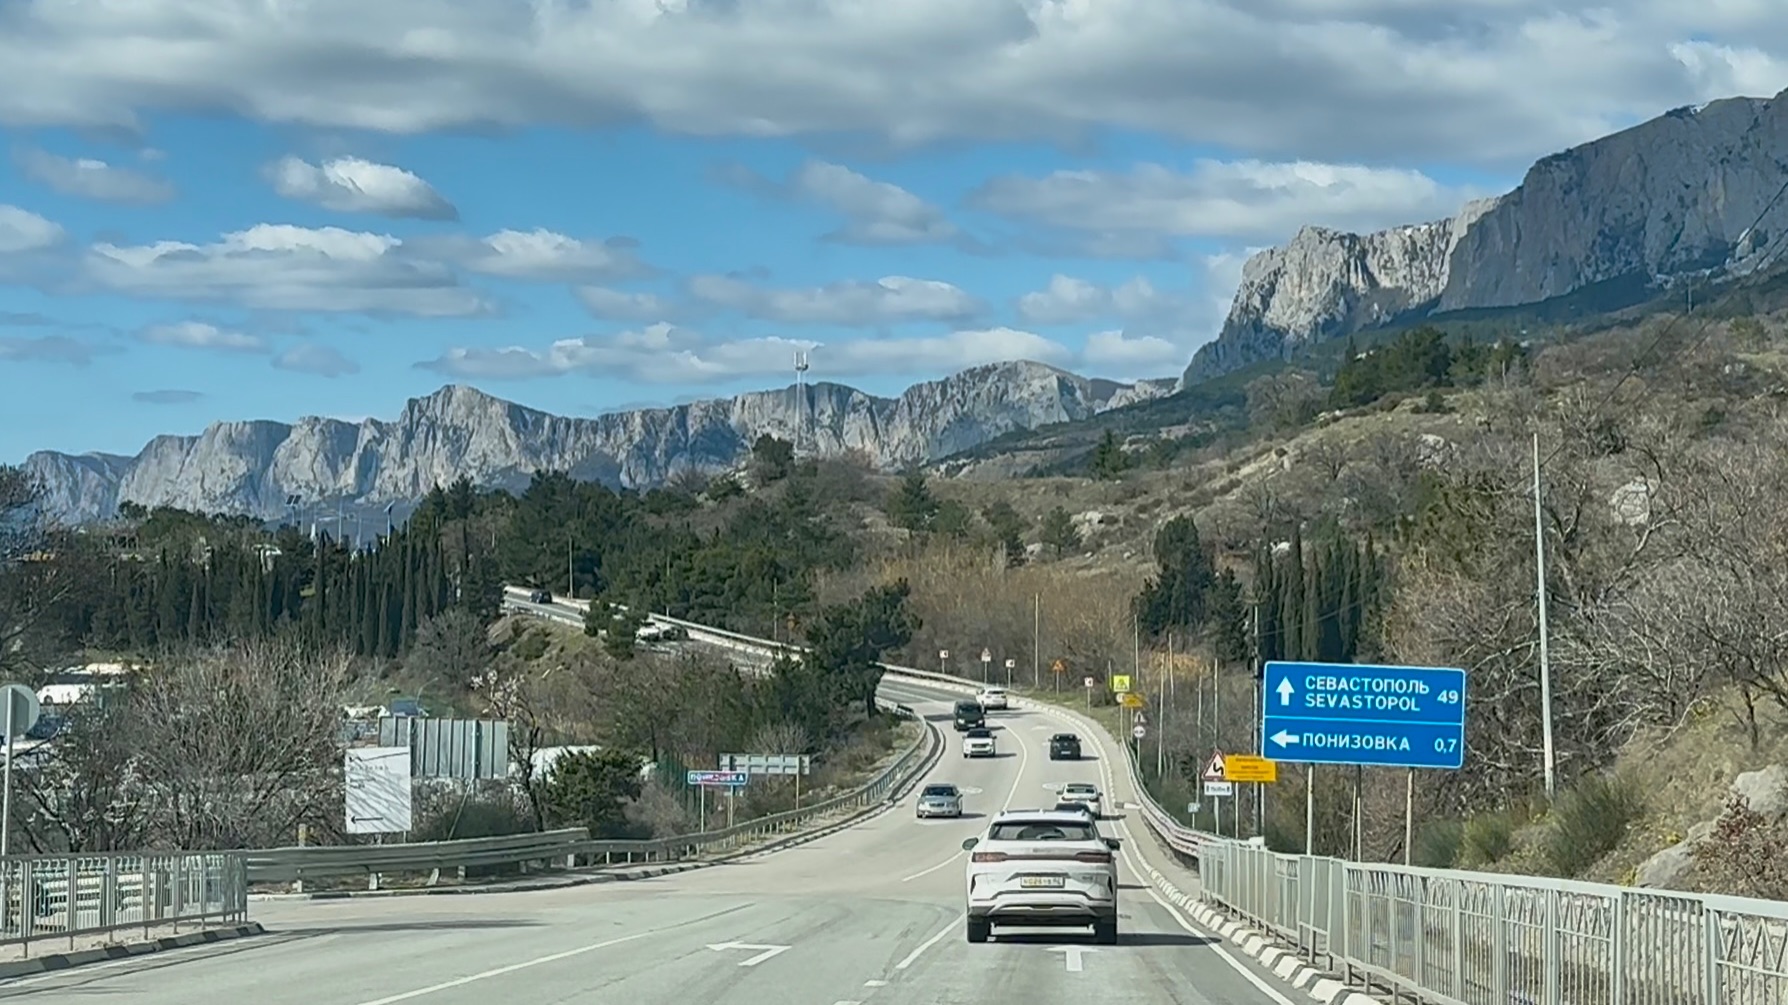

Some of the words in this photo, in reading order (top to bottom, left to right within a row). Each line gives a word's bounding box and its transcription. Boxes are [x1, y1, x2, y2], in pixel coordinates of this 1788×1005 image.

[1305, 675, 1430, 695] СЕВАСТОПОЛЬ
[1305, 693, 1421, 712] SEVASTOPOL
[1437, 689, 1459, 705] 49
[1303, 732, 1410, 751] ПОНИЗОВКА
[1434, 738, 1457, 754] 0,7
[690, 774, 744, 782] ПОЗКА
